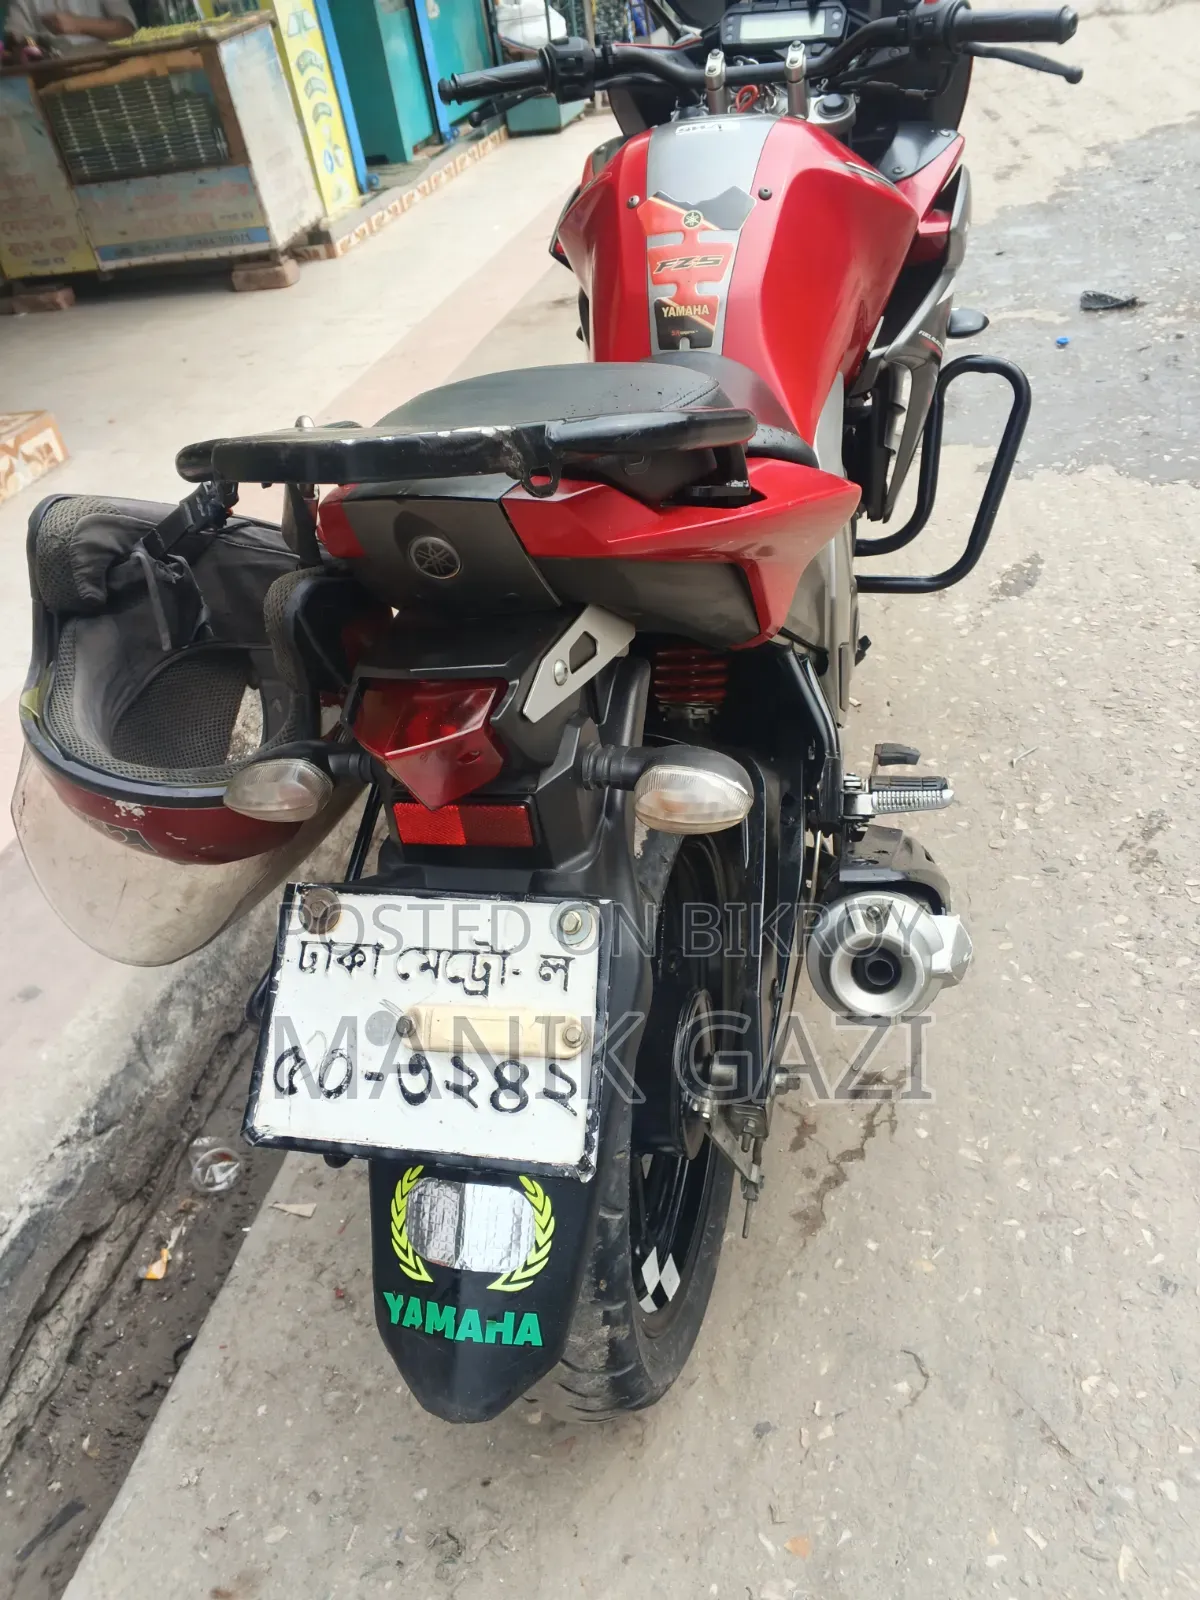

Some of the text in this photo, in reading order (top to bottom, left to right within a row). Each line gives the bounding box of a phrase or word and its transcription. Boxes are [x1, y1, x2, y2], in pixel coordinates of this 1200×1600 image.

[662, 304, 710, 318] YAMAHA
[299, 939, 384, 977] ঢাকা
[383, 1291, 543, 1347] YAMAHA
